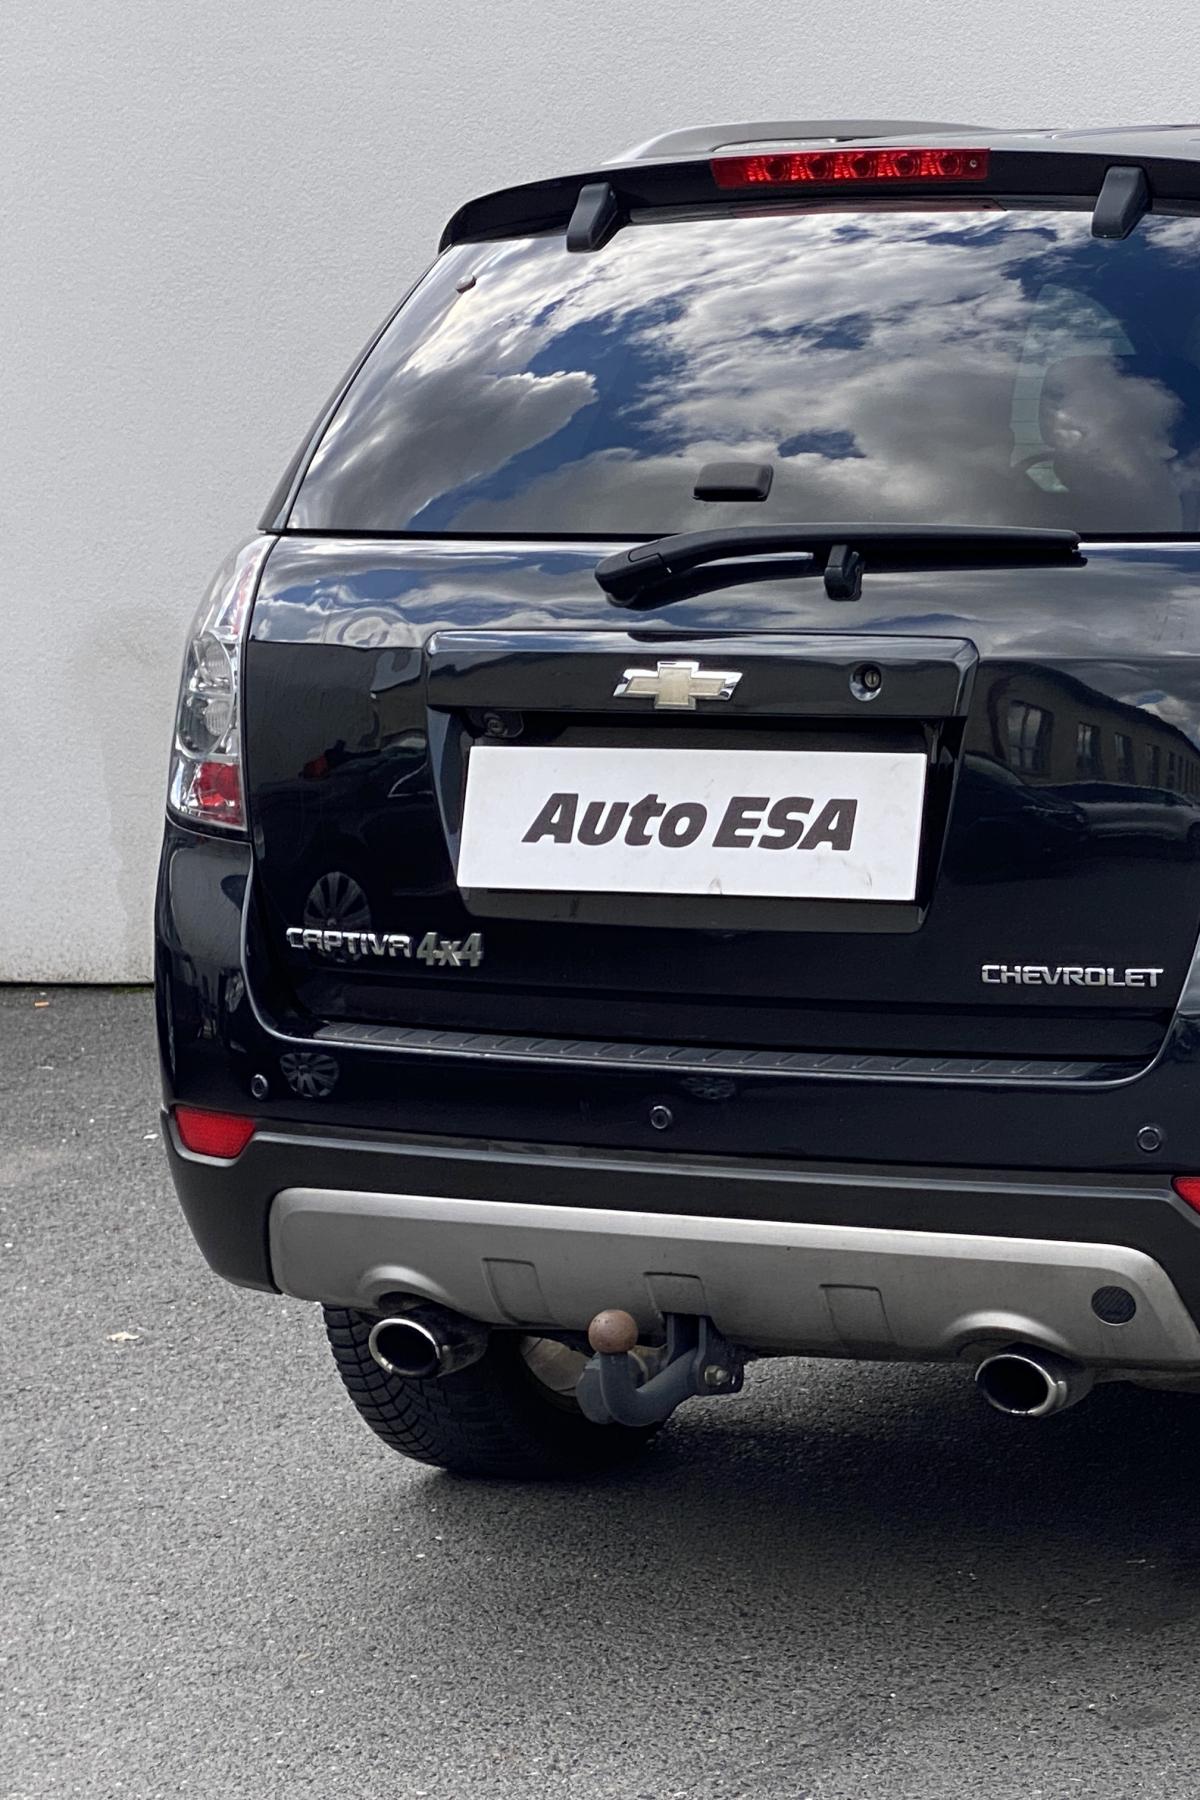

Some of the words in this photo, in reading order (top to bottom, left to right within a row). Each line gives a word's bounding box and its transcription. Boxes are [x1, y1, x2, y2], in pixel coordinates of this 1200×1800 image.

[520, 792, 708, 848] Auto
[711, 795, 859, 852] ESA
[285, 927, 412, 959] CAPTIVA
[415, 931, 484, 967] 4x4
[981, 964, 1164, 988] CHEVROLET
